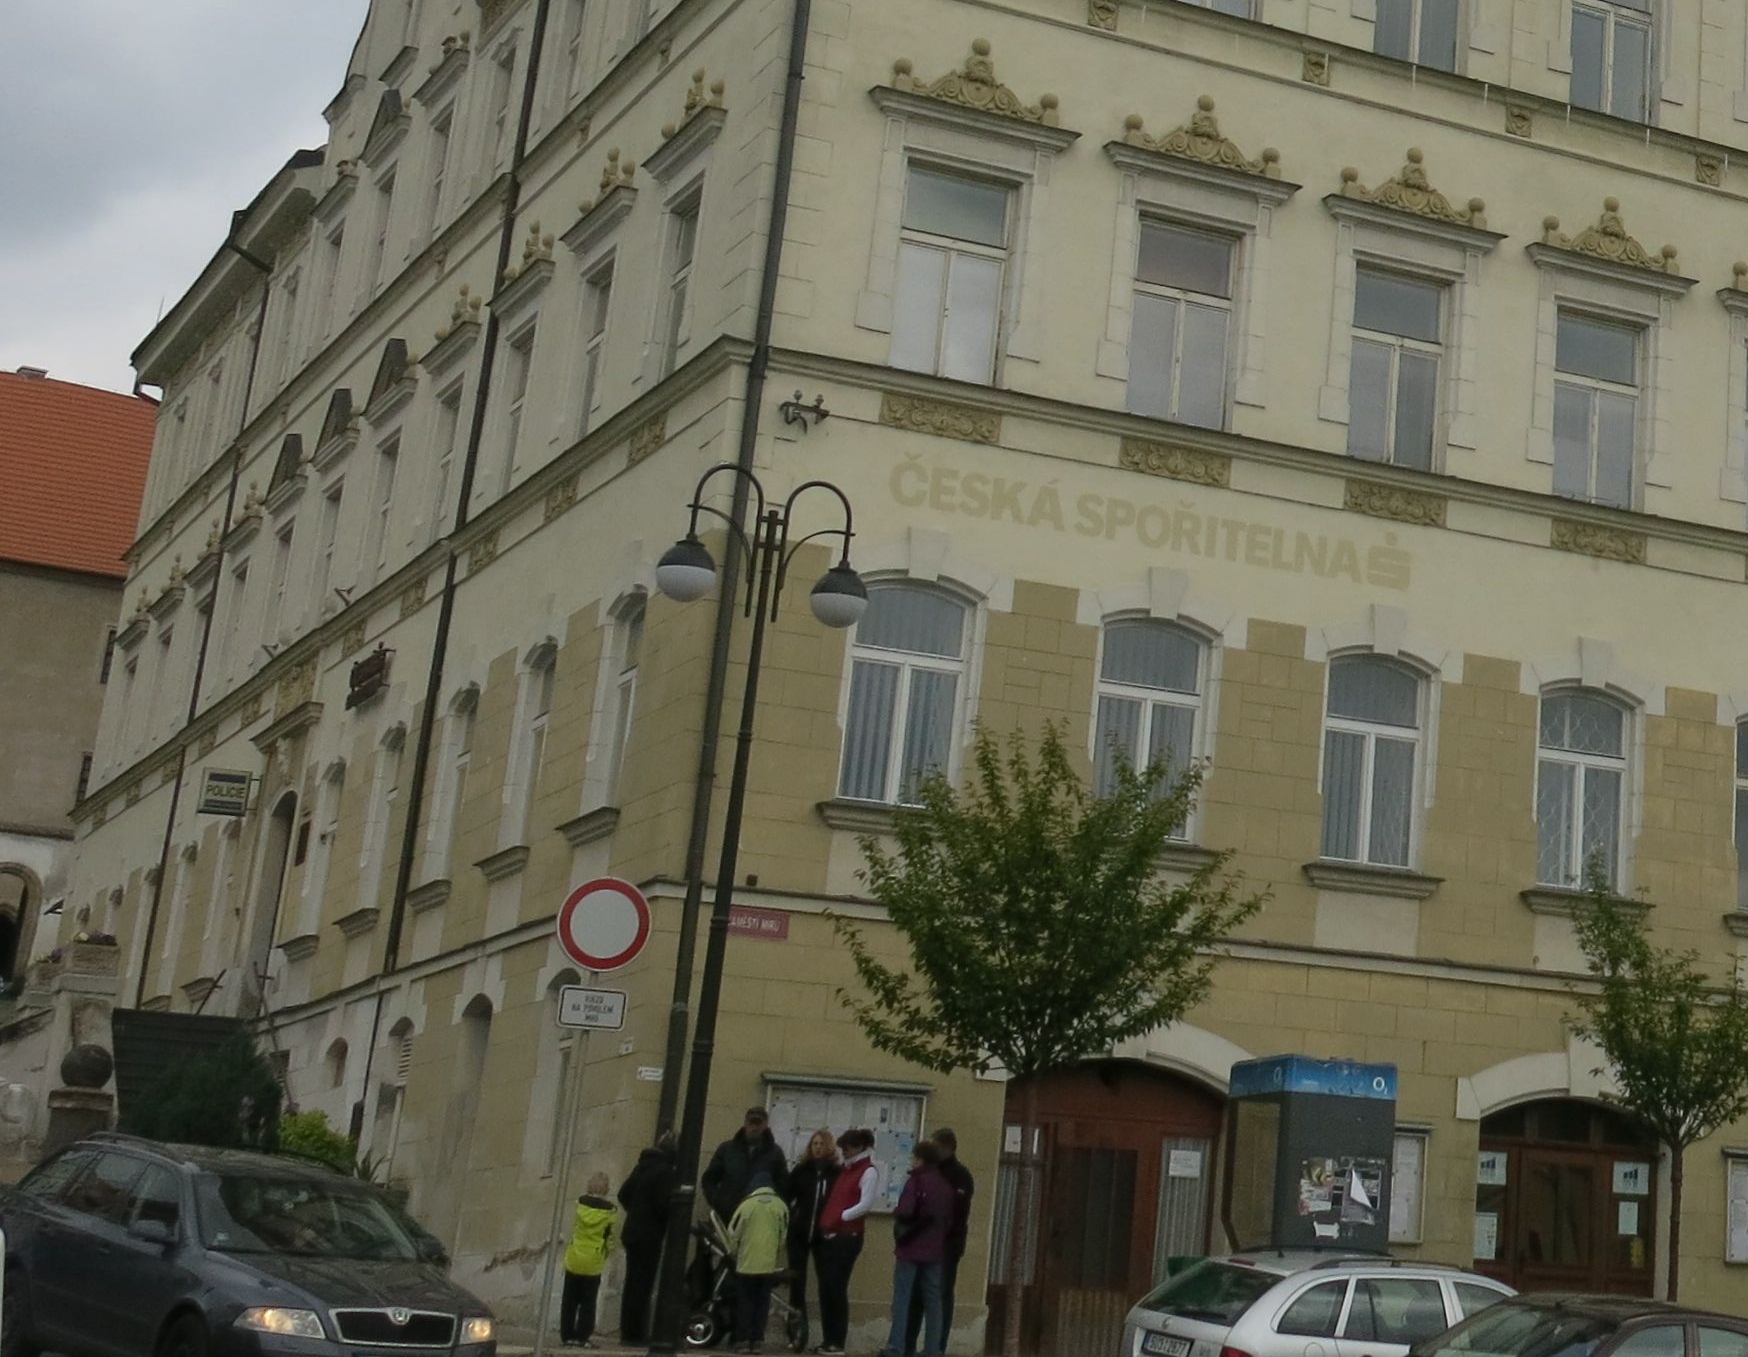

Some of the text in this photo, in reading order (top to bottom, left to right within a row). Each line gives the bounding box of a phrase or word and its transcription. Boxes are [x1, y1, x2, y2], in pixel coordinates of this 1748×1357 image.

[889, 452, 1065, 532] ČESKÁ
[1073, 492, 1362, 583] SPOŘITELNA
[207, 784, 246, 799] POLICIE
